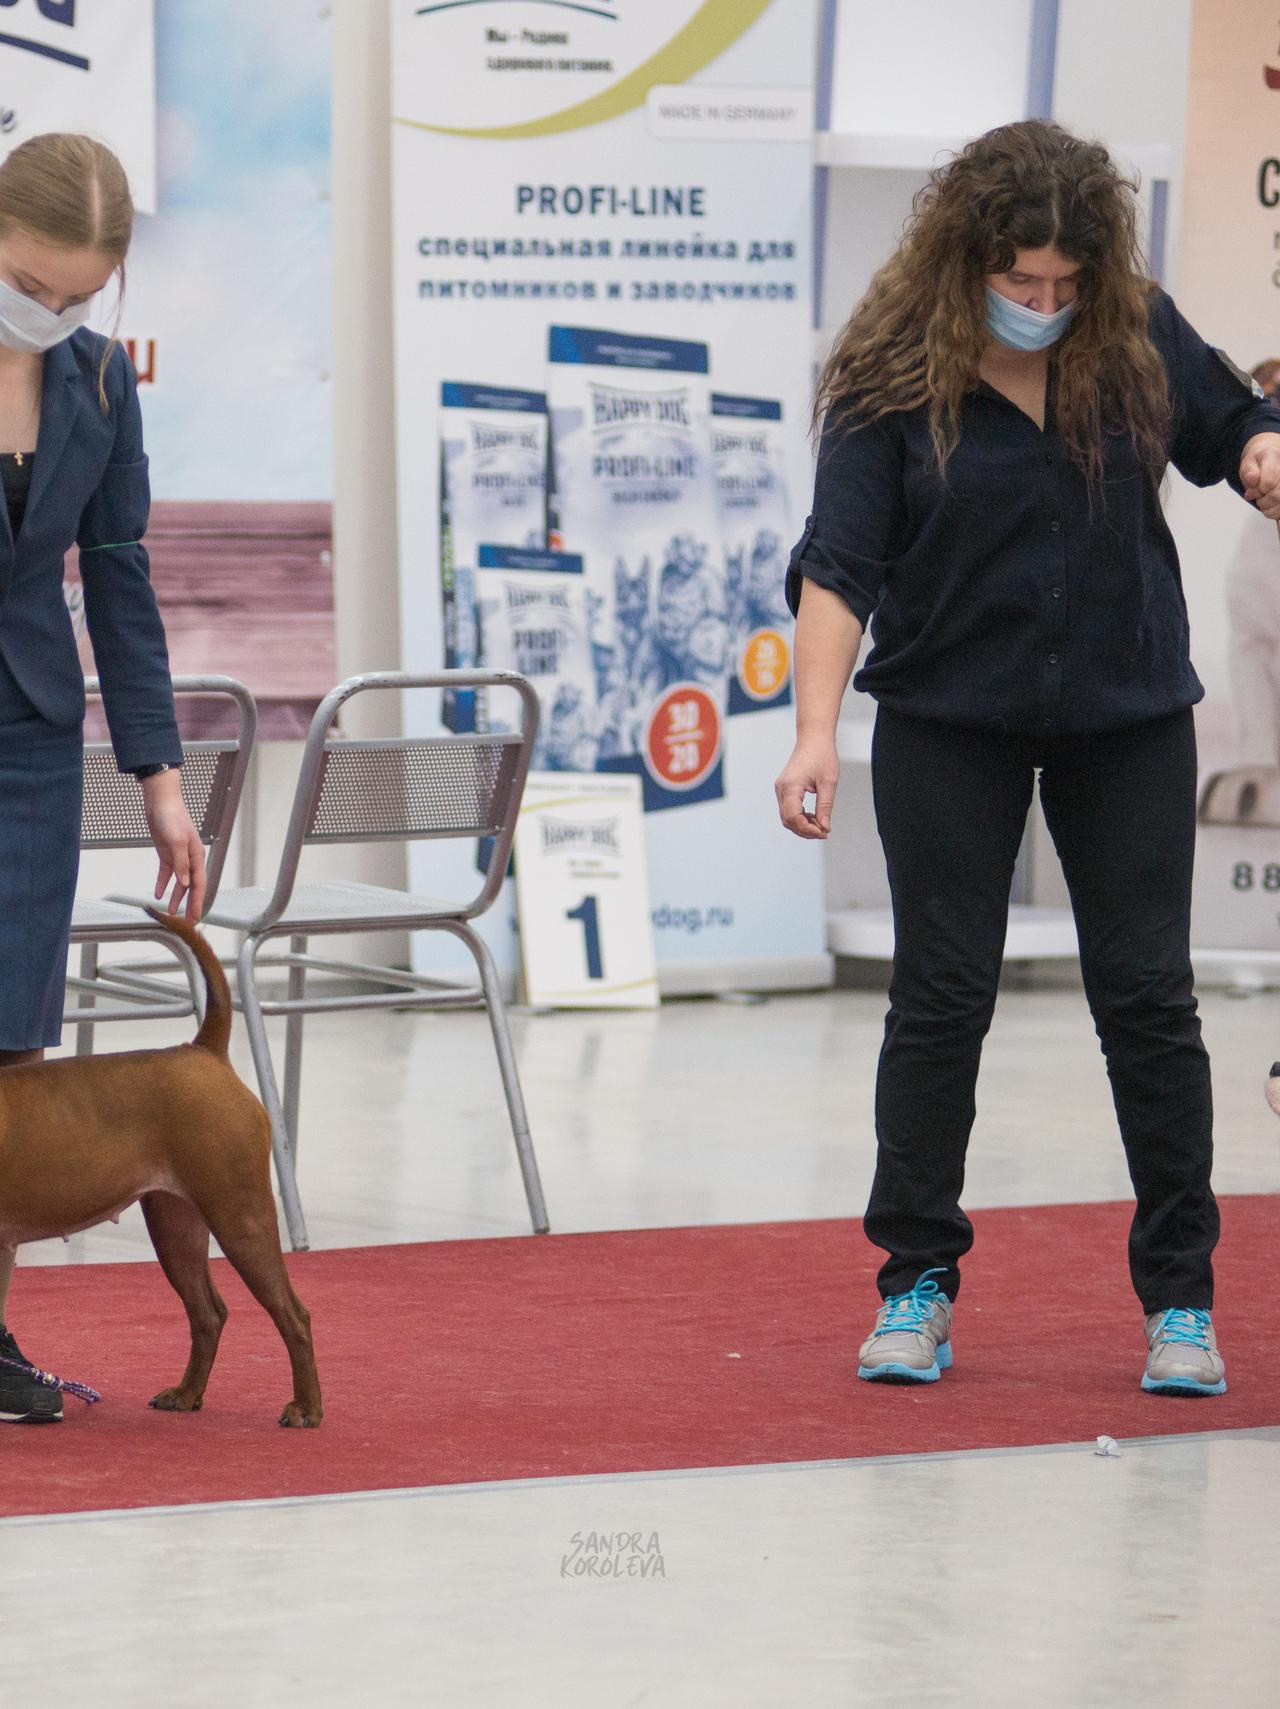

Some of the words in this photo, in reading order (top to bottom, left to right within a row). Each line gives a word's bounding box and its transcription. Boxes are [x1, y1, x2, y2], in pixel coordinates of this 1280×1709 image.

[515, 185, 706, 217] PROFI-LINE
[418, 236, 612, 261] специальная
[620, 233, 738, 260] линейка
[746, 241, 796, 263] для
[418, 279, 596, 302] питомников
[607, 282, 620, 300] и
[629, 280, 797, 302] заводчиков
[652, 907, 734, 934] dog.ru
[567, 896, 603, 978] 1
